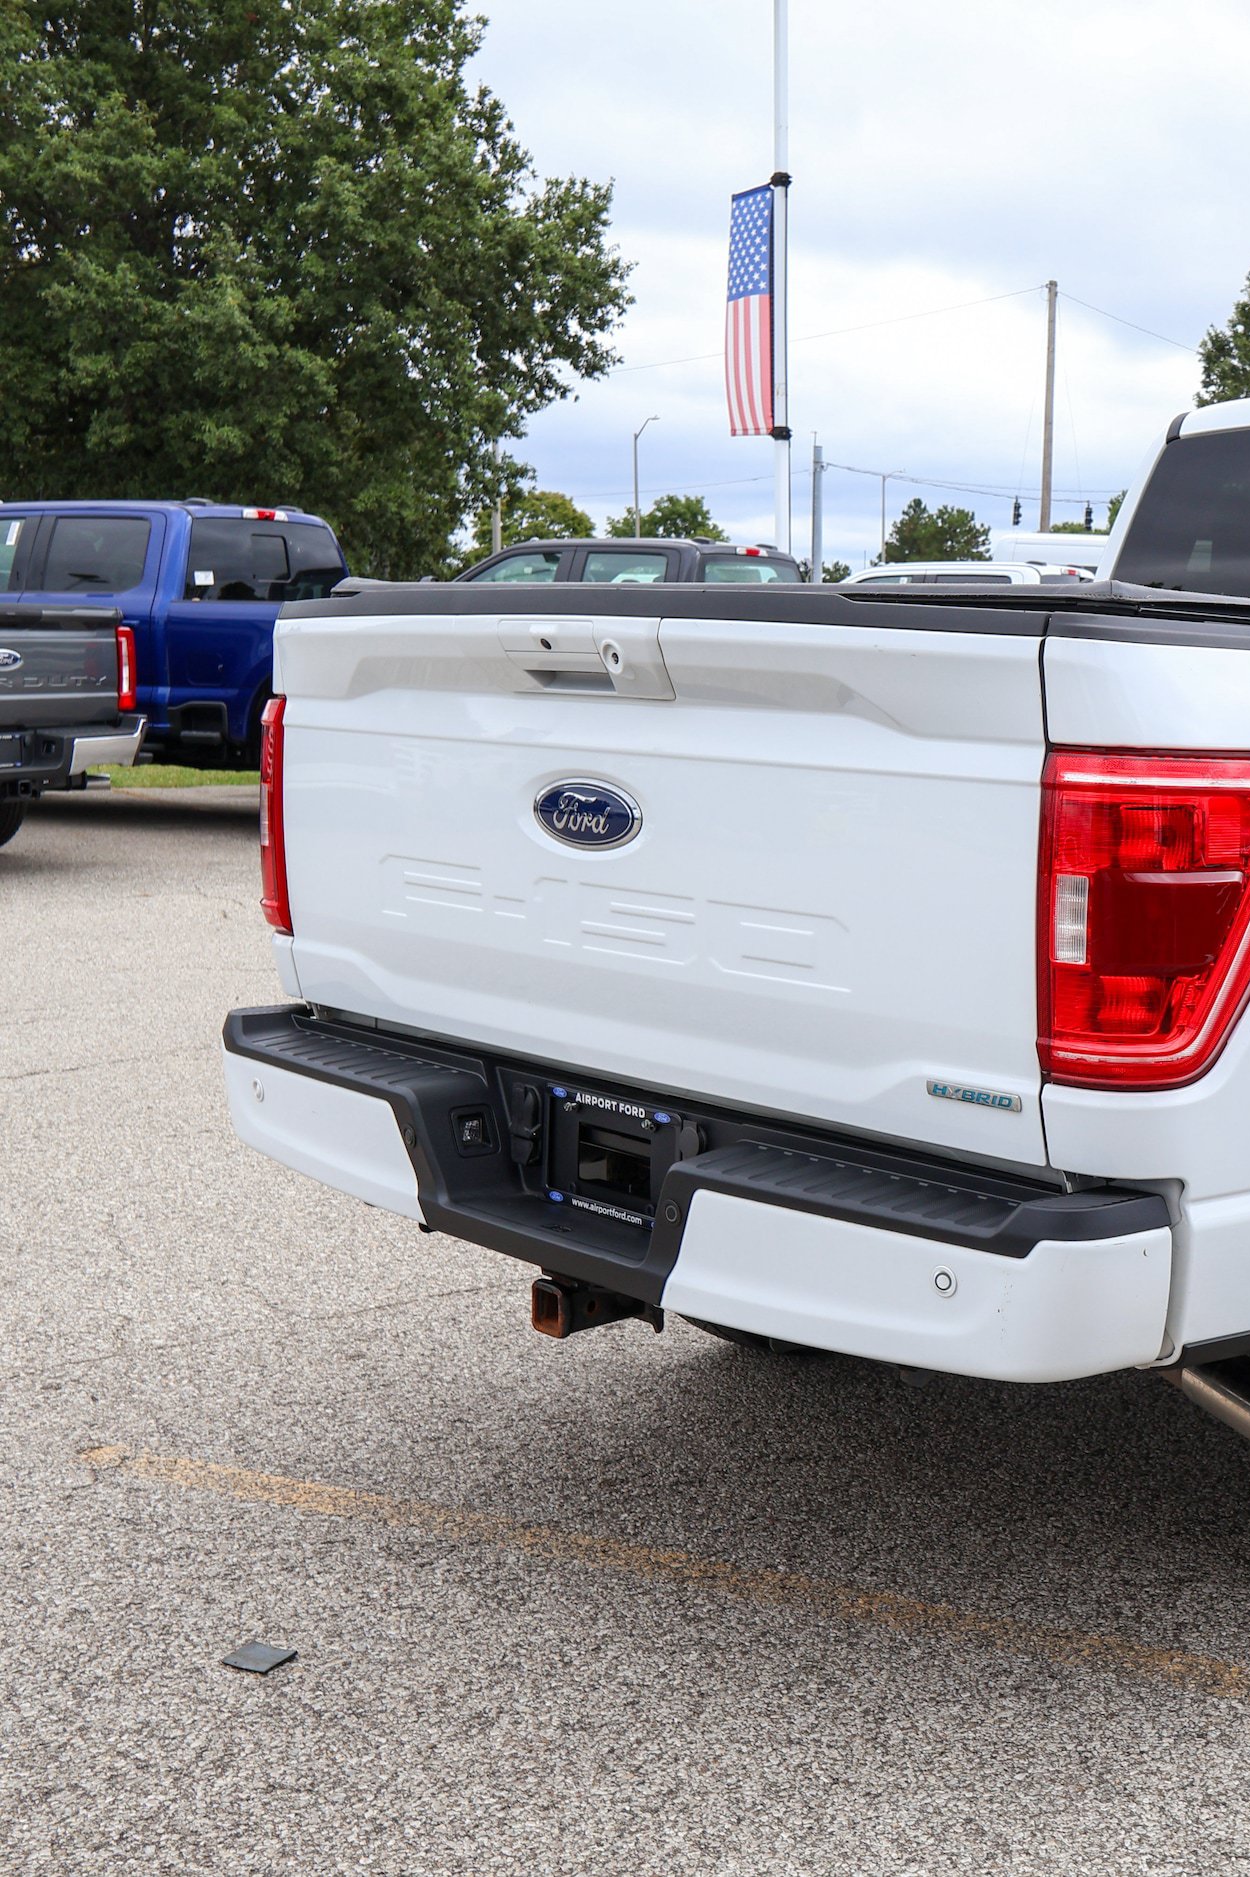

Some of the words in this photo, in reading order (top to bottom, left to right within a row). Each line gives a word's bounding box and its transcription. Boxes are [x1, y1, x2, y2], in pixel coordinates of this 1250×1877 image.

[23, 676, 107, 688] DUTY
[552, 791, 611, 835] Ford
[575, 1092, 618, 1113] AIRPORT
[619, 1103, 646, 1119] FORD
[932, 1083, 1013, 1108] HYBRID
[571, 1198, 643, 1226] www.airportford.com
